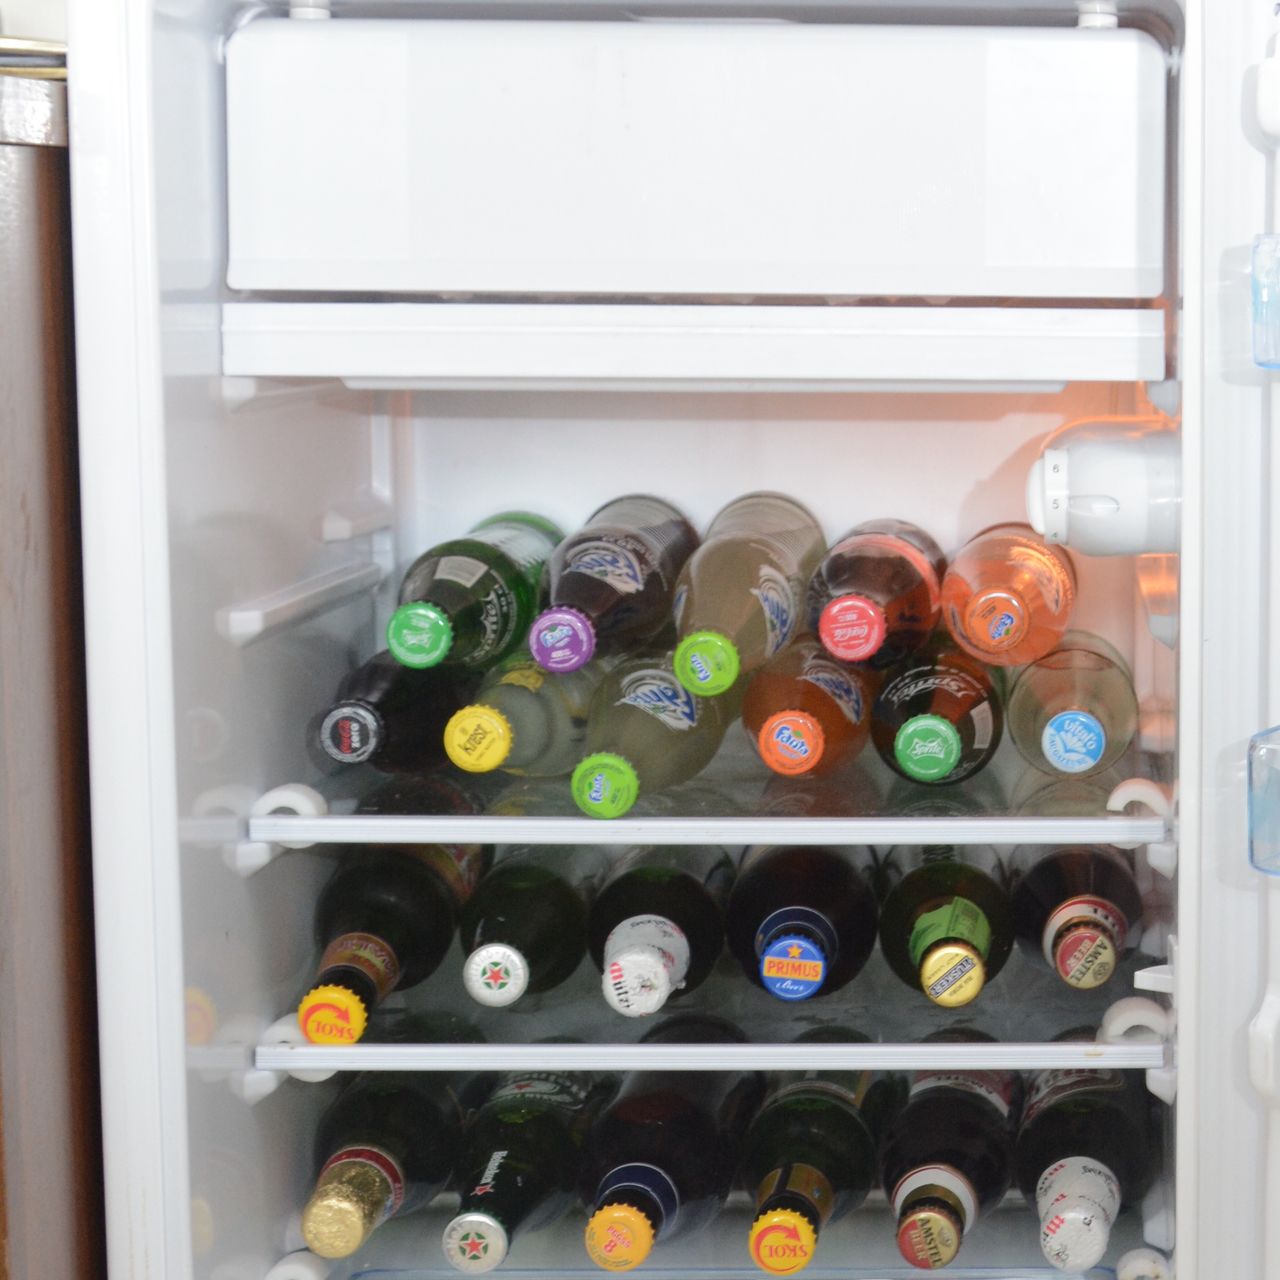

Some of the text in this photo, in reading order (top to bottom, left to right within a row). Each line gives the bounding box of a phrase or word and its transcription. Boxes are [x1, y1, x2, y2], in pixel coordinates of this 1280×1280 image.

[1052, 499, 1059, 509] 5
[540, 625, 573, 648] Fanta
[690, 653, 712, 683] Fanta
[350, 722, 361, 748] zero
[774, 725, 809, 756] Fanta
[912, 740, 944, 755] Sprite
[588, 772, 605, 802] Fanta
[767, 960, 820, 978] PRIMUS
[1071, 936, 1108, 985] AMSTEL
[930, 958, 973, 995] TUSKER
[313, 1020, 355, 1040] SKOL
[764, 1242, 808, 1258] SKOL
[918, 1218, 943, 1265] AMSTEL
